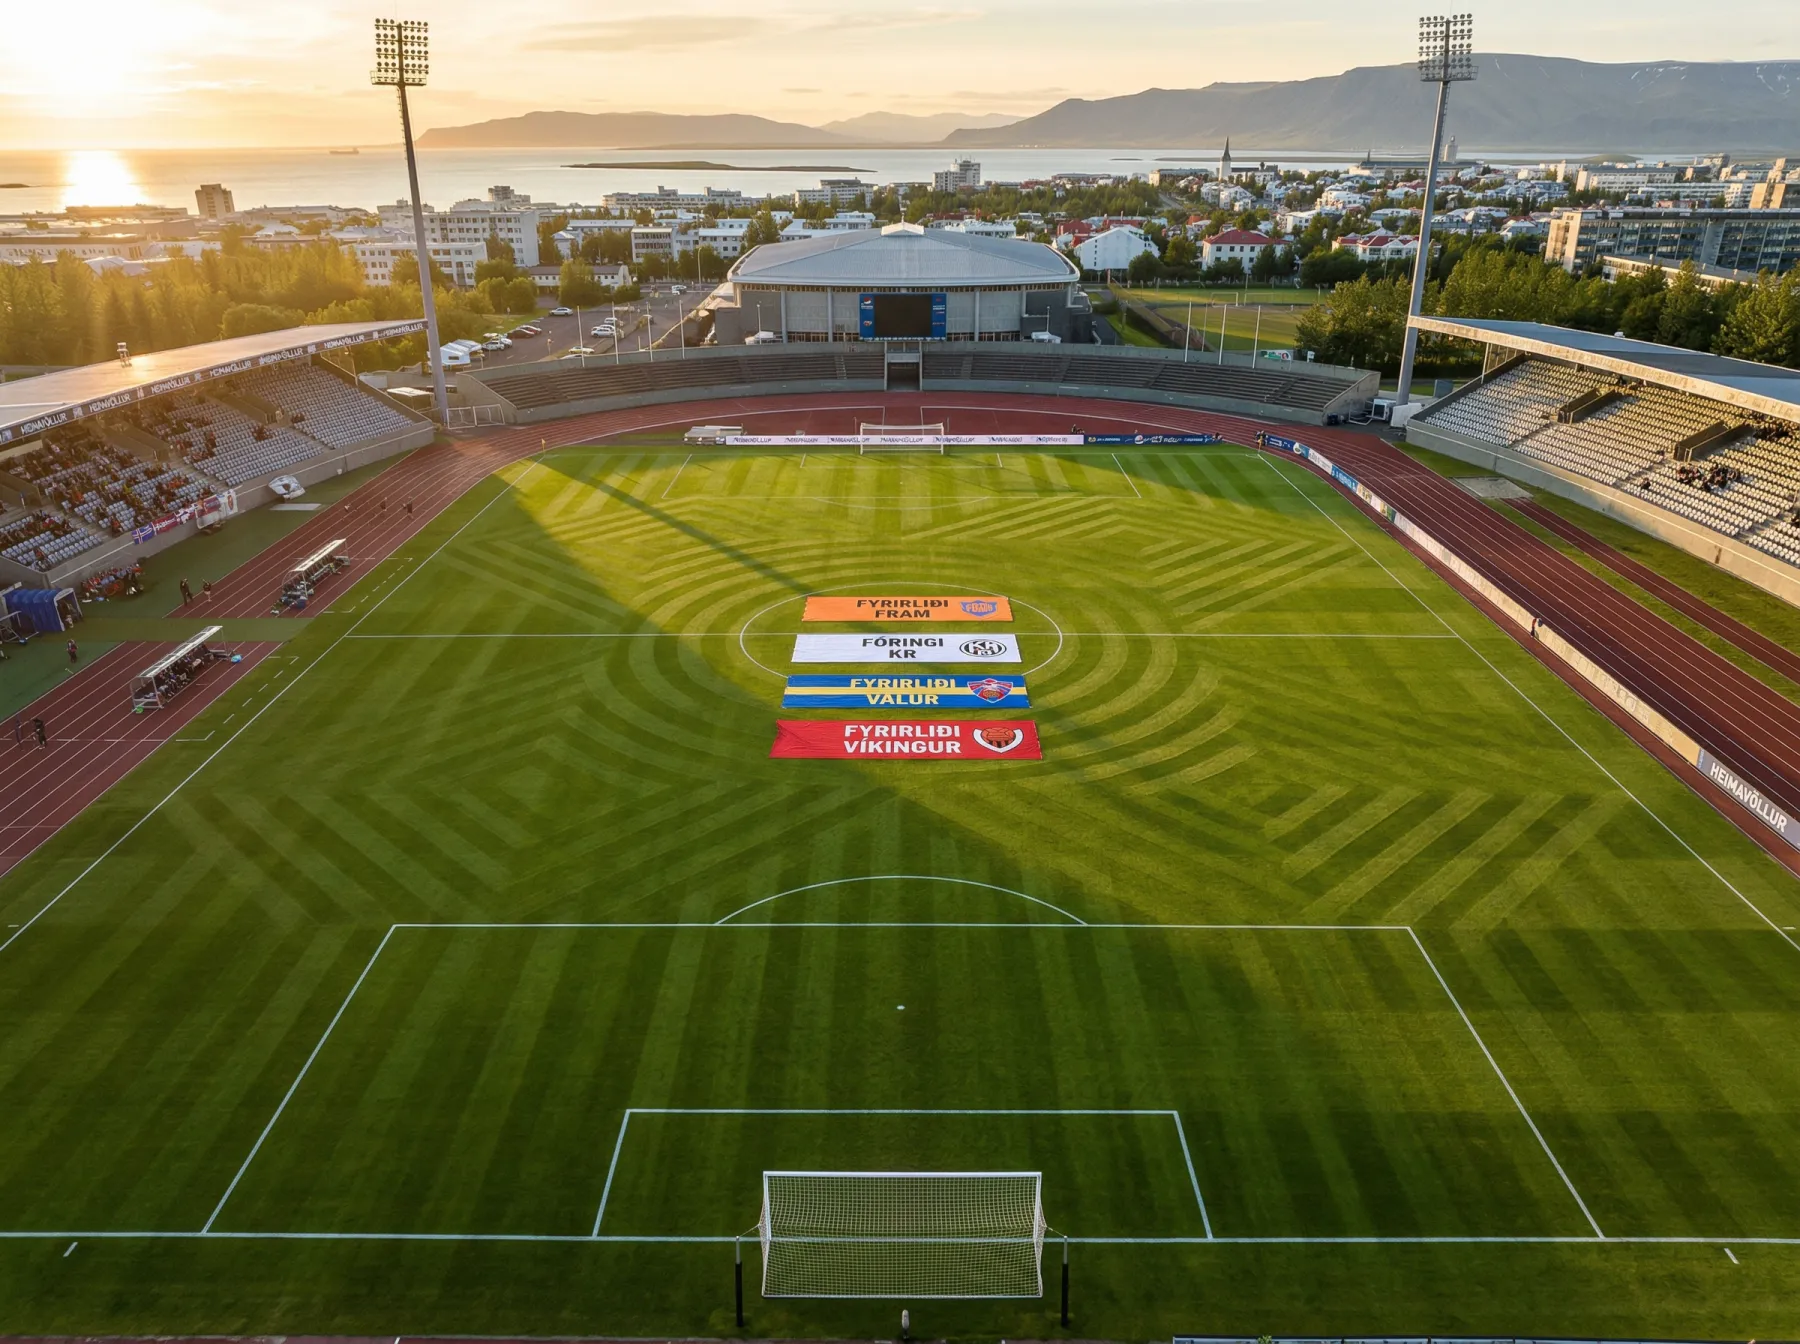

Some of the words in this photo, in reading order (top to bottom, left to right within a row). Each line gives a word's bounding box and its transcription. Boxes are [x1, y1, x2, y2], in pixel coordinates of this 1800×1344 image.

[856, 599, 949, 608] FYRIRLIÐI
[875, 609, 930, 618] FRAM
[862, 636, 944, 647] FÓRINGI
[889, 649, 916, 659] KR
[849, 678, 957, 689] FYRIRLIÐI
[866, 693, 939, 705] VALUR
[844, 725, 960, 738] FYRIRLIÐI
[843, 738, 962, 754] VÍKINGUR
[1710, 762, 1787, 833] HEIMAVÖLLUR
